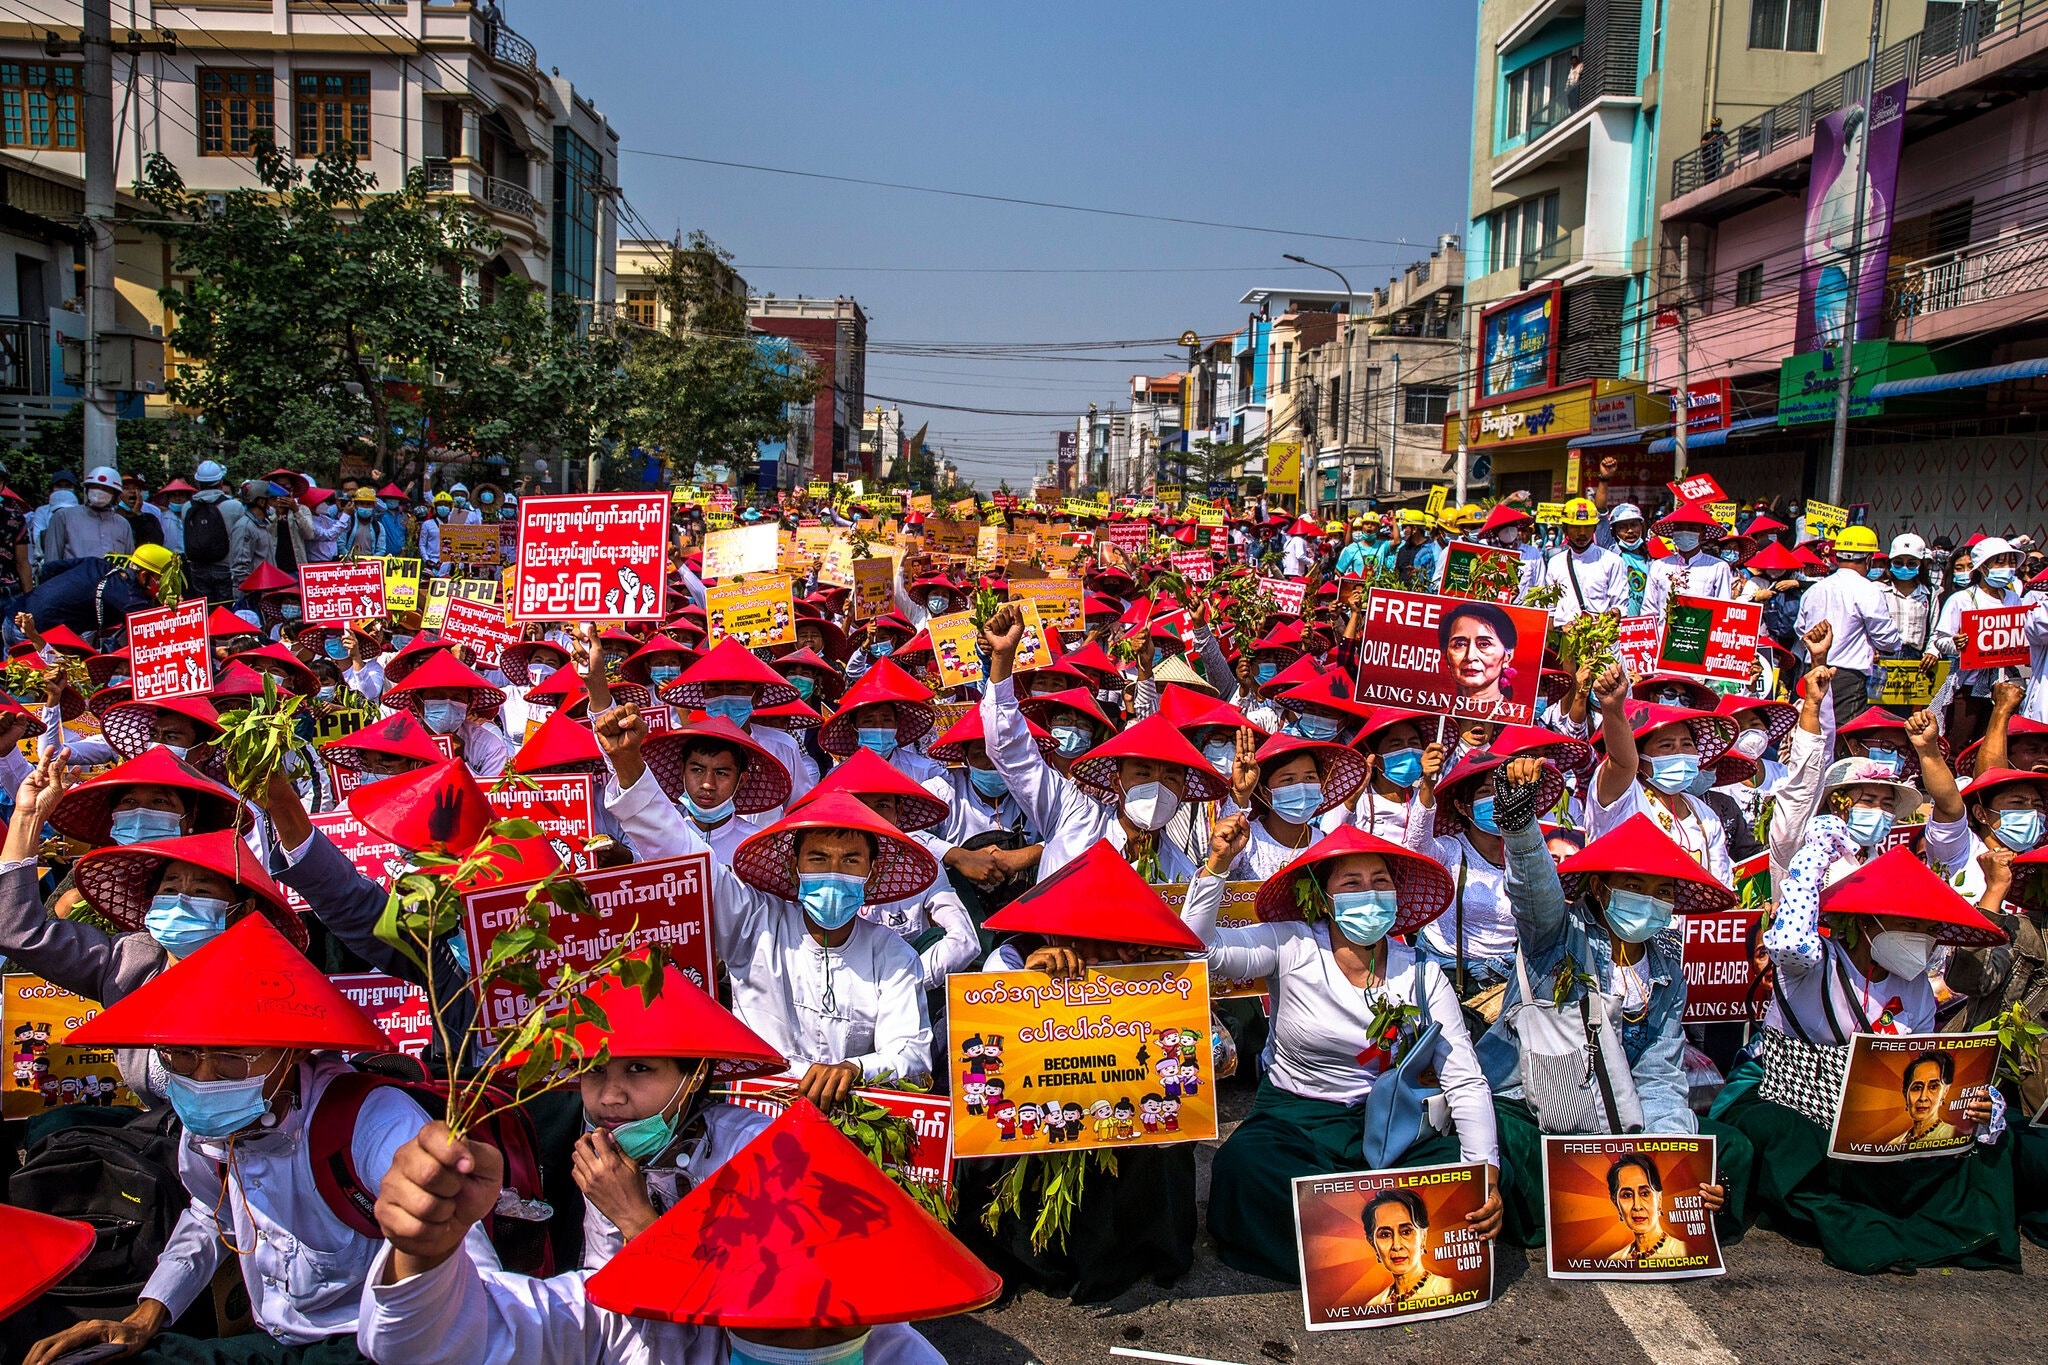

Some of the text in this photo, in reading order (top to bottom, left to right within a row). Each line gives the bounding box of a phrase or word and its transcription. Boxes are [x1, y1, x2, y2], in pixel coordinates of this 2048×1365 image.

[1069, 497, 1091, 507] CRPH
[1191, 497, 1213, 508] CRPH
[1807, 501, 1818, 509] We
[1833, 508, 1849, 517] Accep
[708, 512, 734, 521] CRPH
[986, 507, 1002, 516] RPH
[1807, 508, 1834, 519] MILITARY
[431, 580, 494, 600] CRPH
[523, 572, 602, 612] ဖွဲ့စည်းကြ
[736, 613, 761, 621] BECOMING
[1368, 596, 1442, 630] FREE
[735, 620, 755, 628] FEDERAL
[755, 617, 771, 625] UNION
[1362, 639, 1441, 674] OUR LEADER
[1363, 683, 1527, 719] AUNG SAN SUU KYI
[1685, 918, 1747, 944] FREE
[1683, 960, 1749, 986] OUR LEADER
[1684, 1002, 1728, 1017] AUNG
[1871, 1038, 1998, 1051] FREE OUR LEADERS
[66, 1053, 115, 1065] A FEDER
[1044, 1054, 1117, 1071] BECOMING
[1023, 1068, 1147, 1088] A FEDERAL UNION
[1563, 1141, 1699, 1154] FREE OUR LEADERS
[1850, 1134, 1972, 1153] WE WANT DEMOCRACY
[1313, 1170, 1472, 1195] FREE OUR LEADERS
[1674, 1196, 1702, 1209] REJECT
[1668, 1209, 1704, 1224] MILITARY
[1687, 1222, 1707, 1236] COUP
[1434, 1242, 1481, 1261] MILITARY
[1457, 1256, 1483, 1271] COUP
[1567, 1255, 1710, 1269] WE WANT DEMOCRACY
[1325, 1290, 1480, 1318] WE WANT DEMOCRACY
